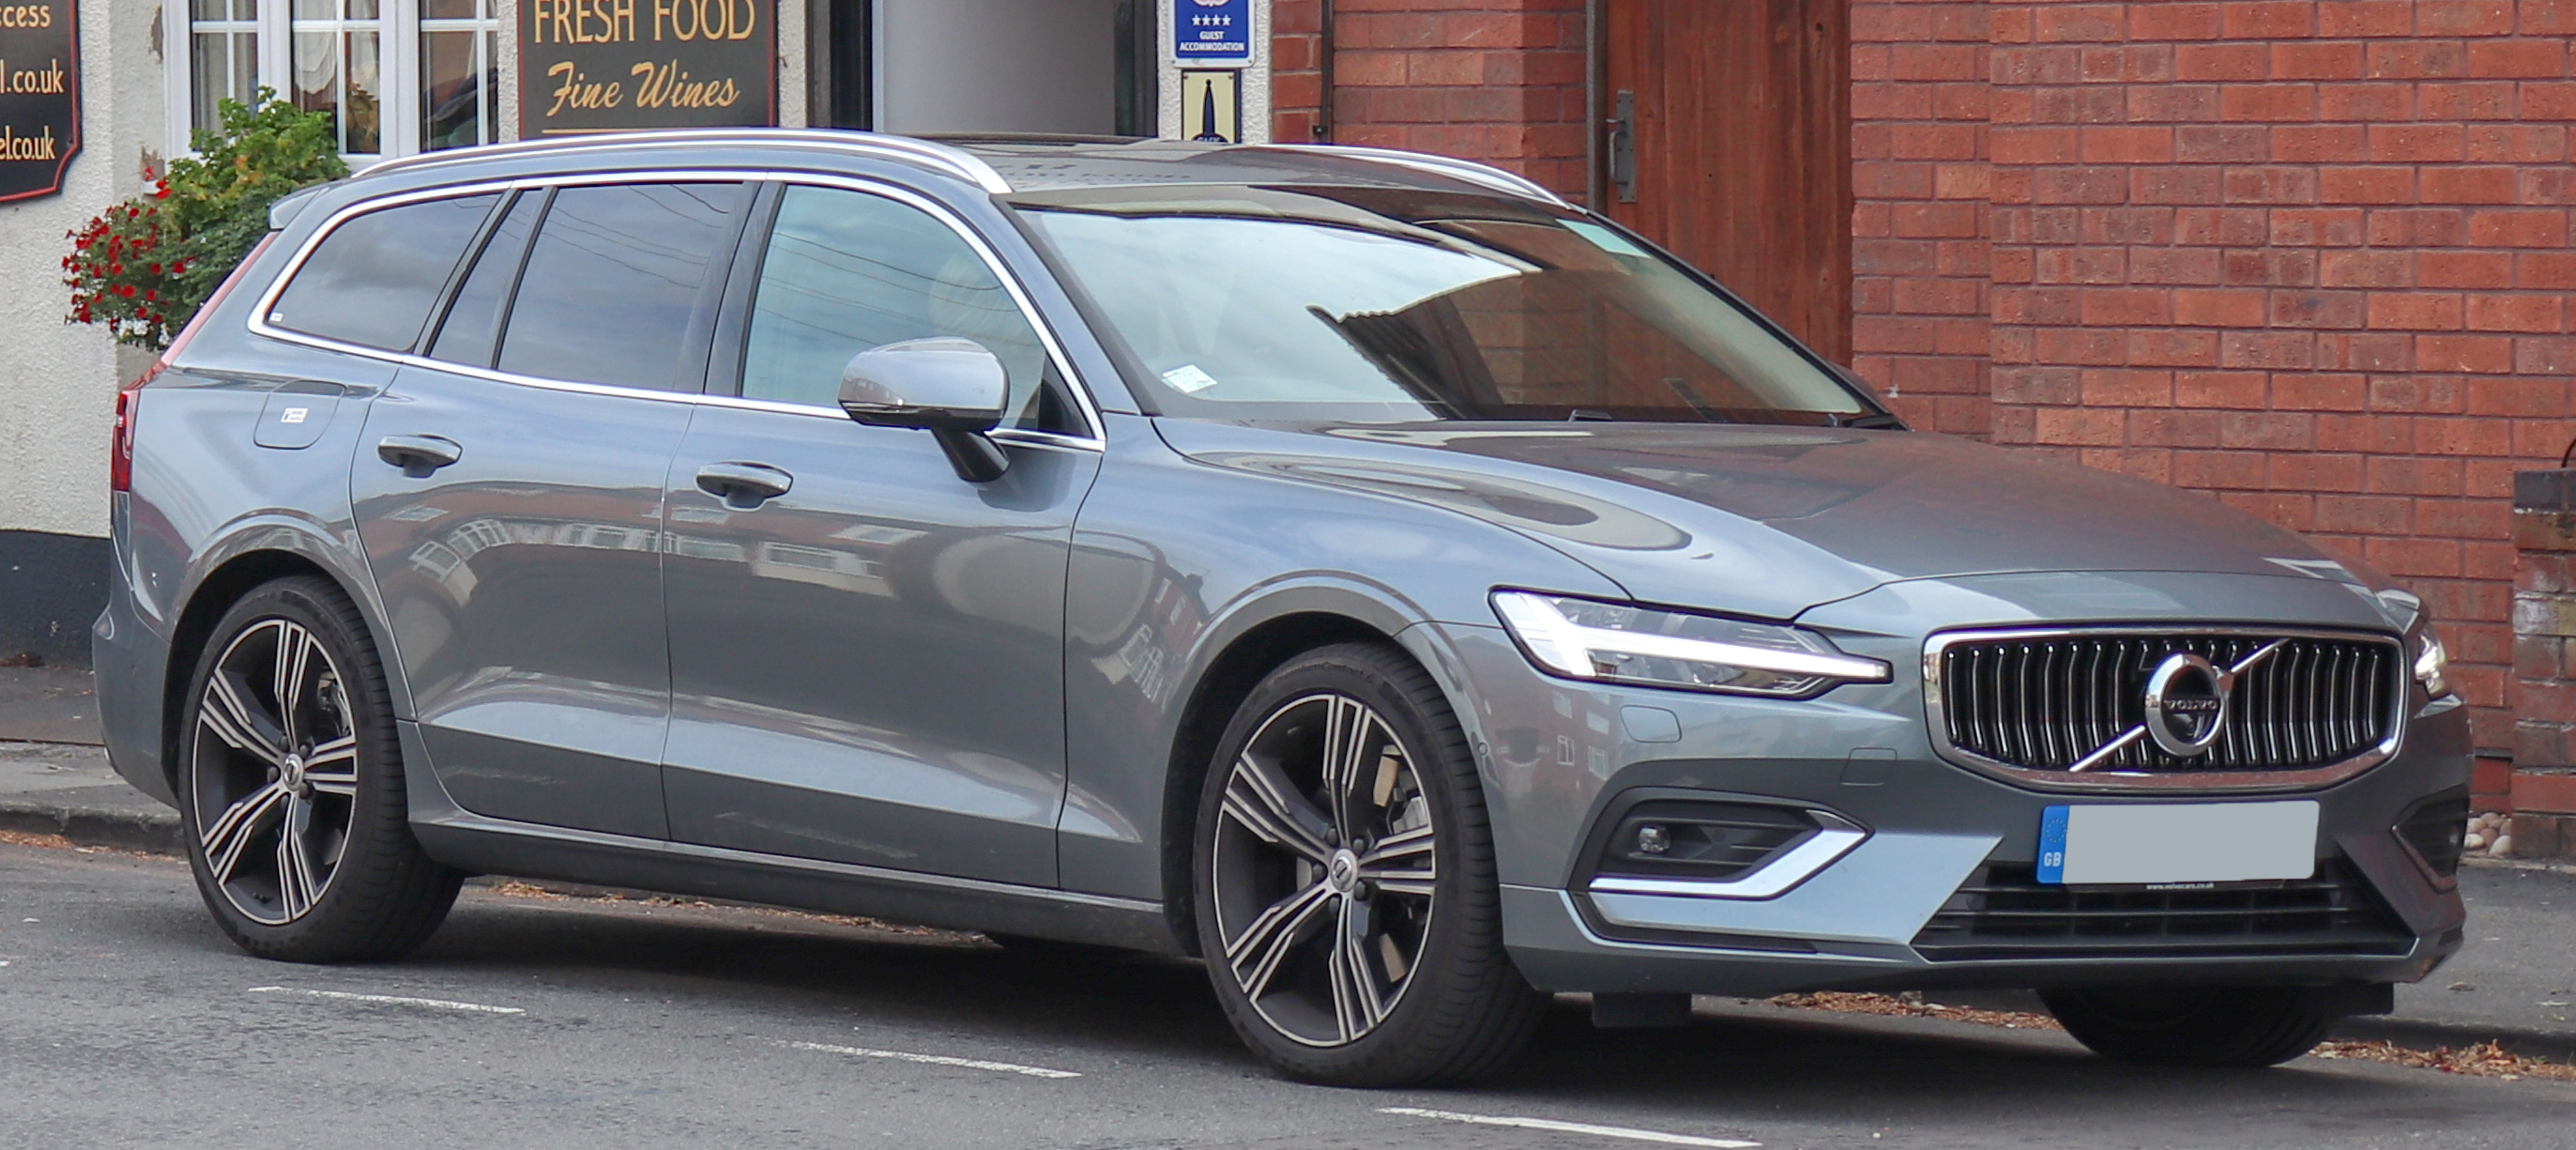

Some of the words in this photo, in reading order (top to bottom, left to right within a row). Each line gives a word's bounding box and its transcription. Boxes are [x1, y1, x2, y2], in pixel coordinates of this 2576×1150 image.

[0, 5, 51, 27] cess
[534, 0, 634, 43] FRESH
[654, 0, 755, 41] FOOD
[1199, 31, 1225, 39] GUEST
[1180, 42, 1244, 51] ACCOMMODATION
[546, 61, 623, 117] Fine
[631, 58, 740, 109] Wines
[2163, 699, 2217, 710] VOLVO
[2044, 851, 2062, 866] GB
